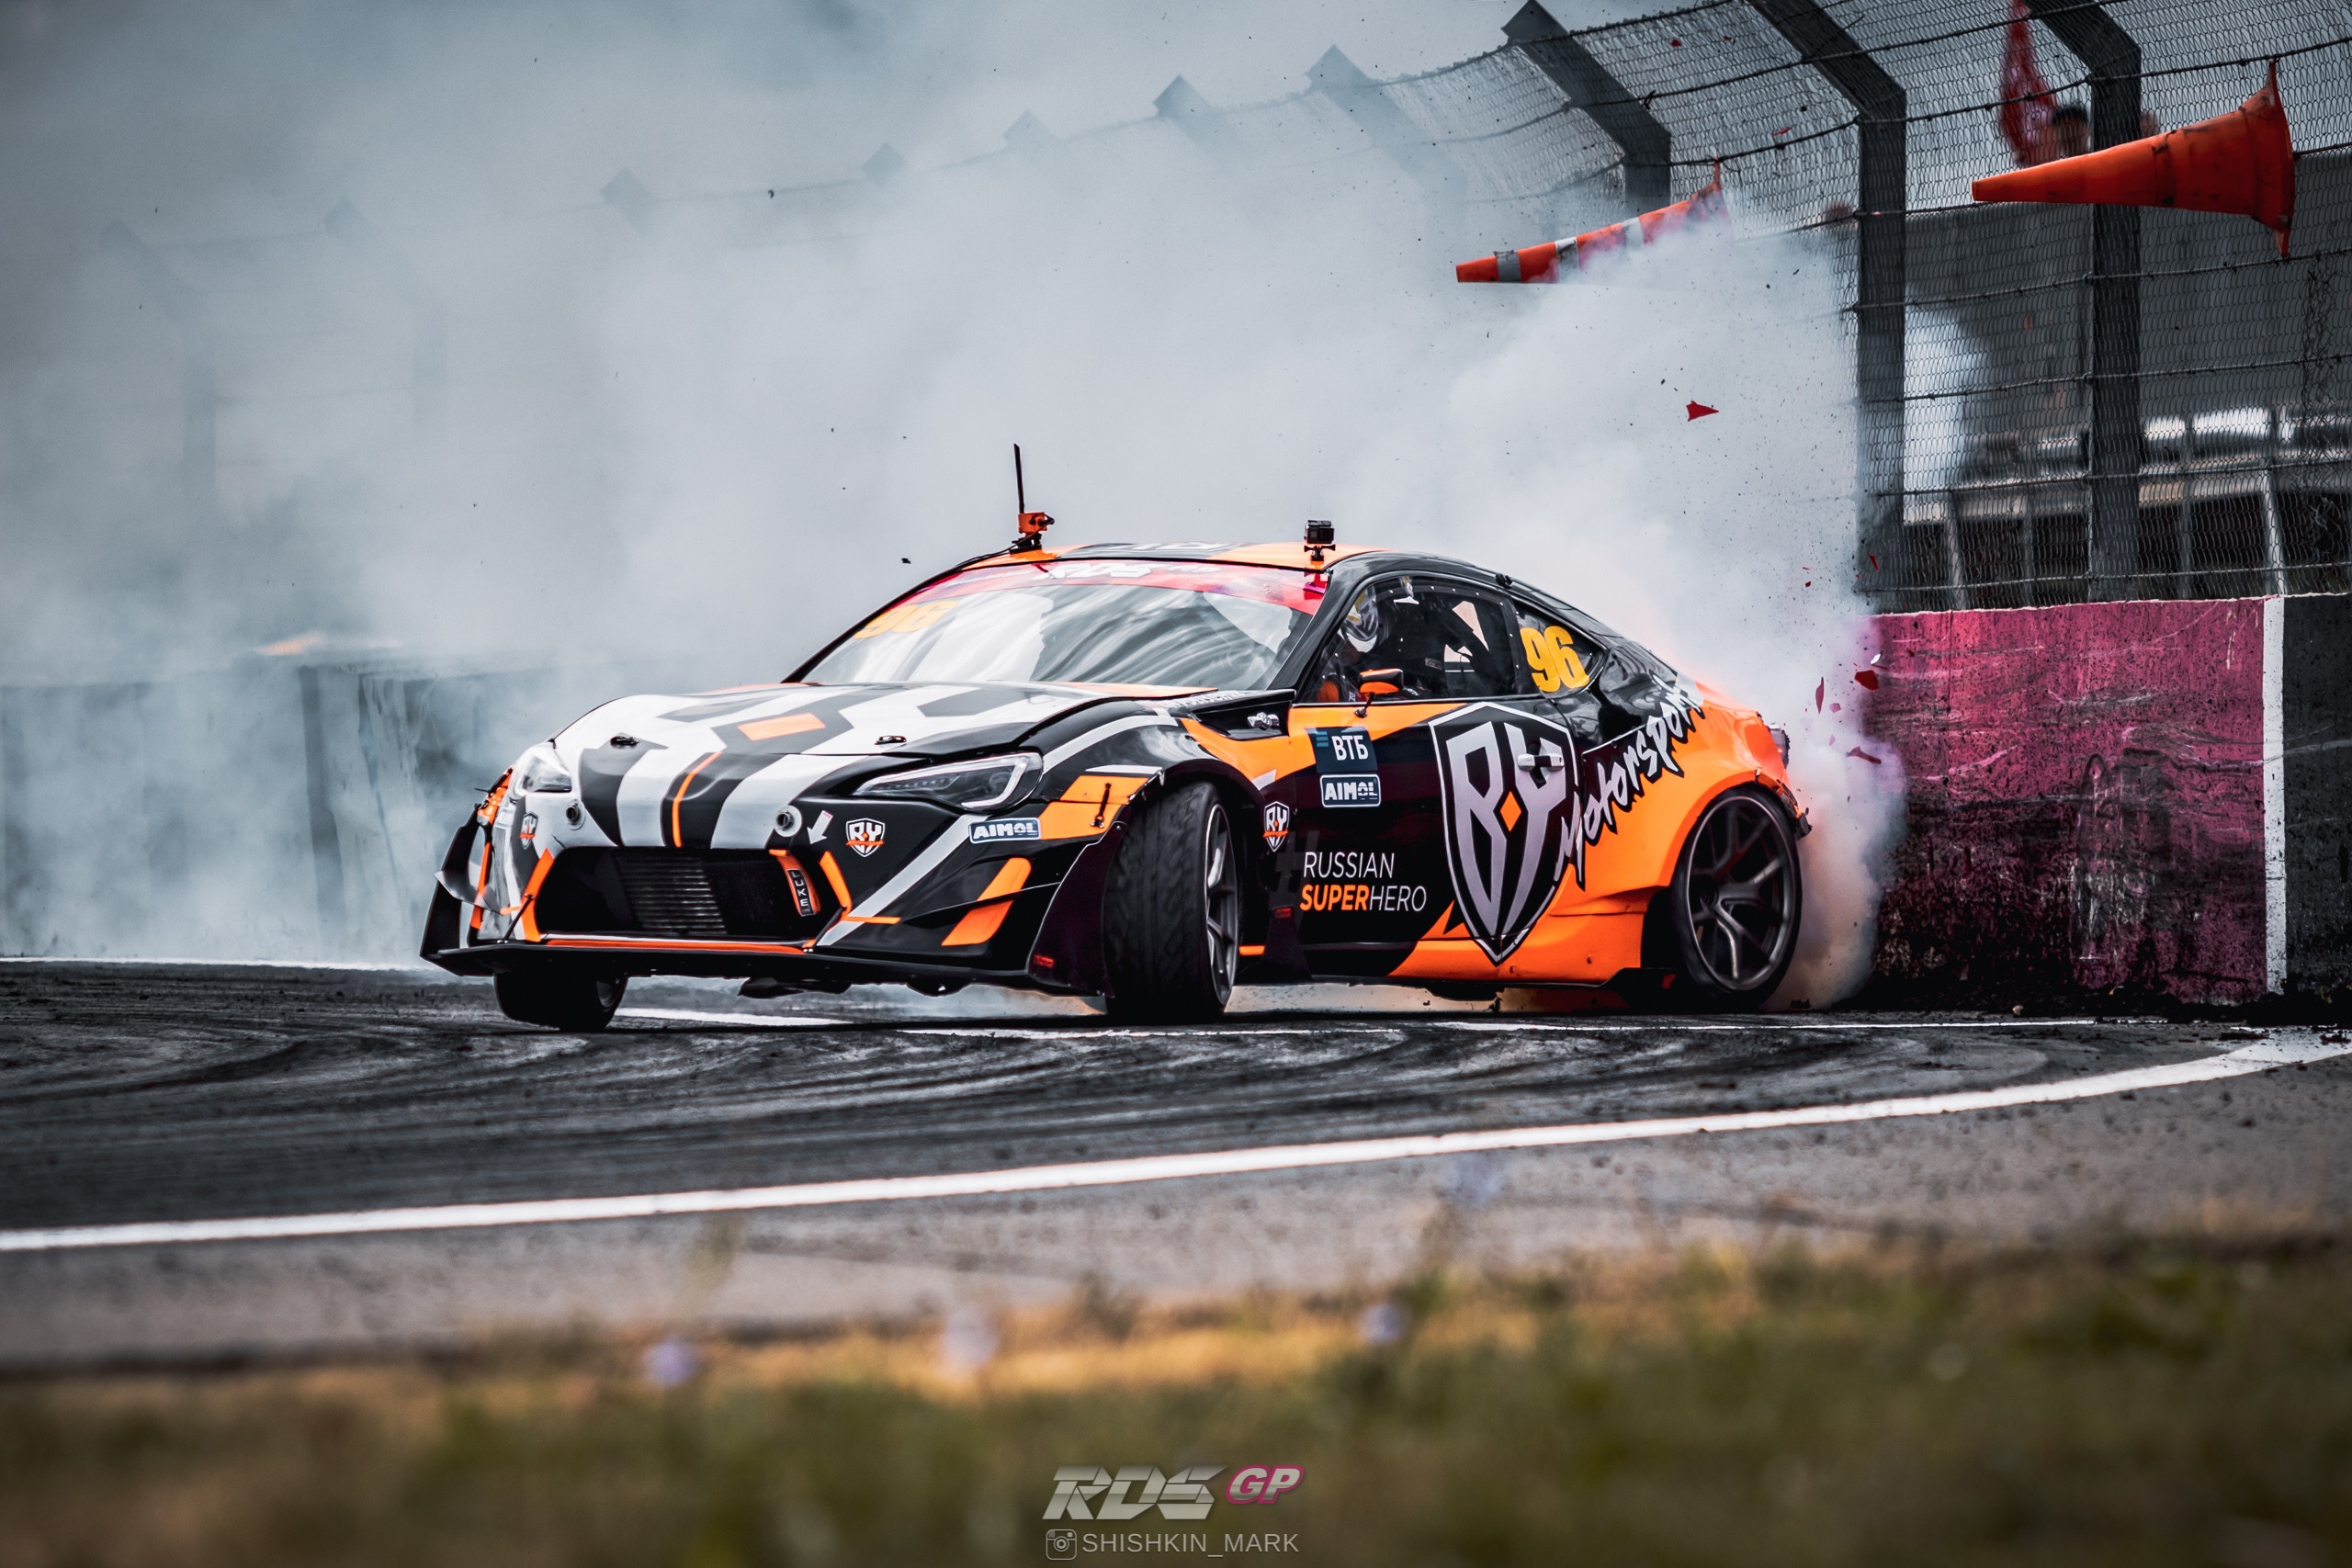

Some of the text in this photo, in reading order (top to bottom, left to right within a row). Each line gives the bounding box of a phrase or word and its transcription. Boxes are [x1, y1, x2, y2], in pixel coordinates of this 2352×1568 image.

[853, 600, 959, 640] 96
[1520, 626, 1590, 693] 96
[1331, 734, 1369, 761] ВТБ
[1324, 782, 1378, 801] AIMOL
[973, 821, 1038, 840] AIMOL
[1303, 852, 1396, 879] RUSSIAN
[1299, 884, 1428, 912] SUPERHERO
